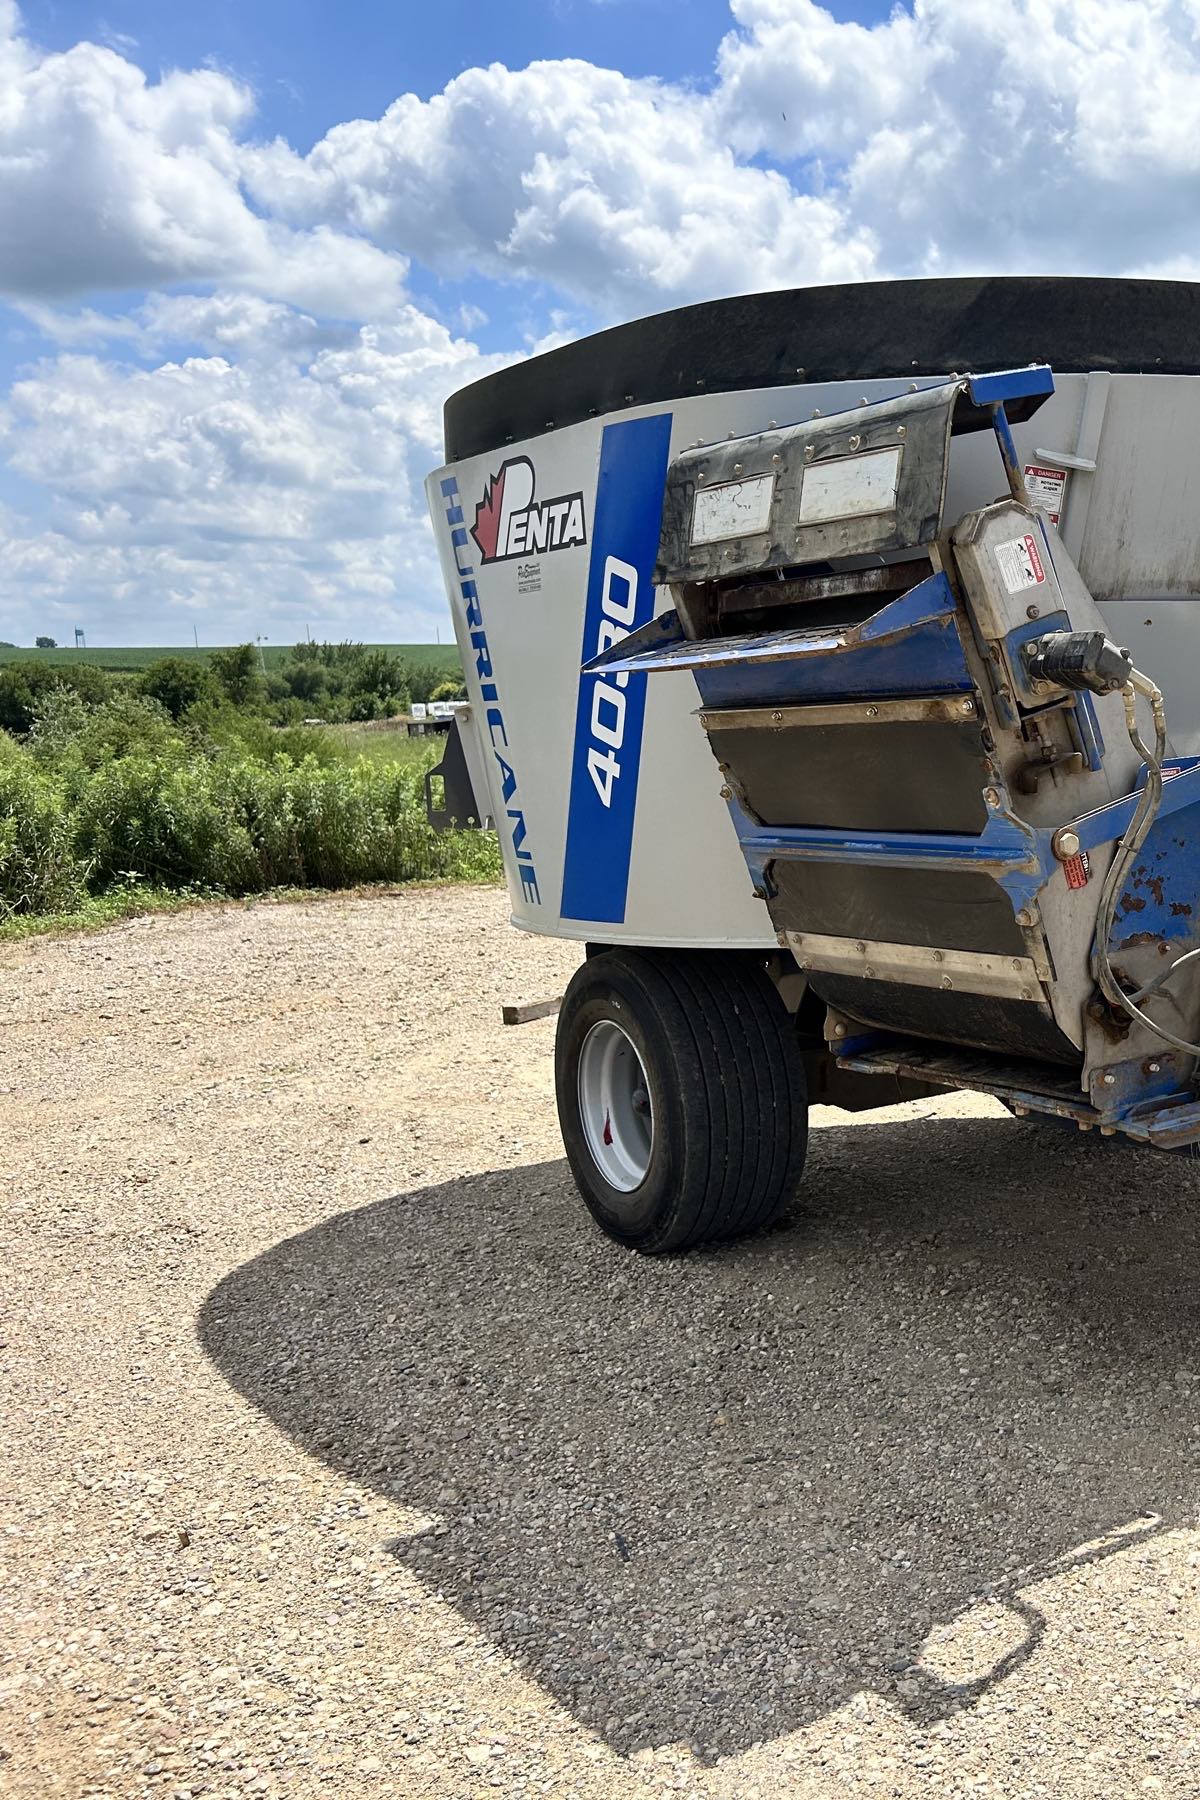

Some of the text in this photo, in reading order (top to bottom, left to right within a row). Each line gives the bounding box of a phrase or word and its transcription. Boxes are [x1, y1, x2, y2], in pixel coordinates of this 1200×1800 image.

[1038, 470, 1061, 479] DANGER
[496, 462, 584, 558] PENTA
[1029, 544, 1043, 577] WARNING
[440, 477, 542, 906] HURRICANE
